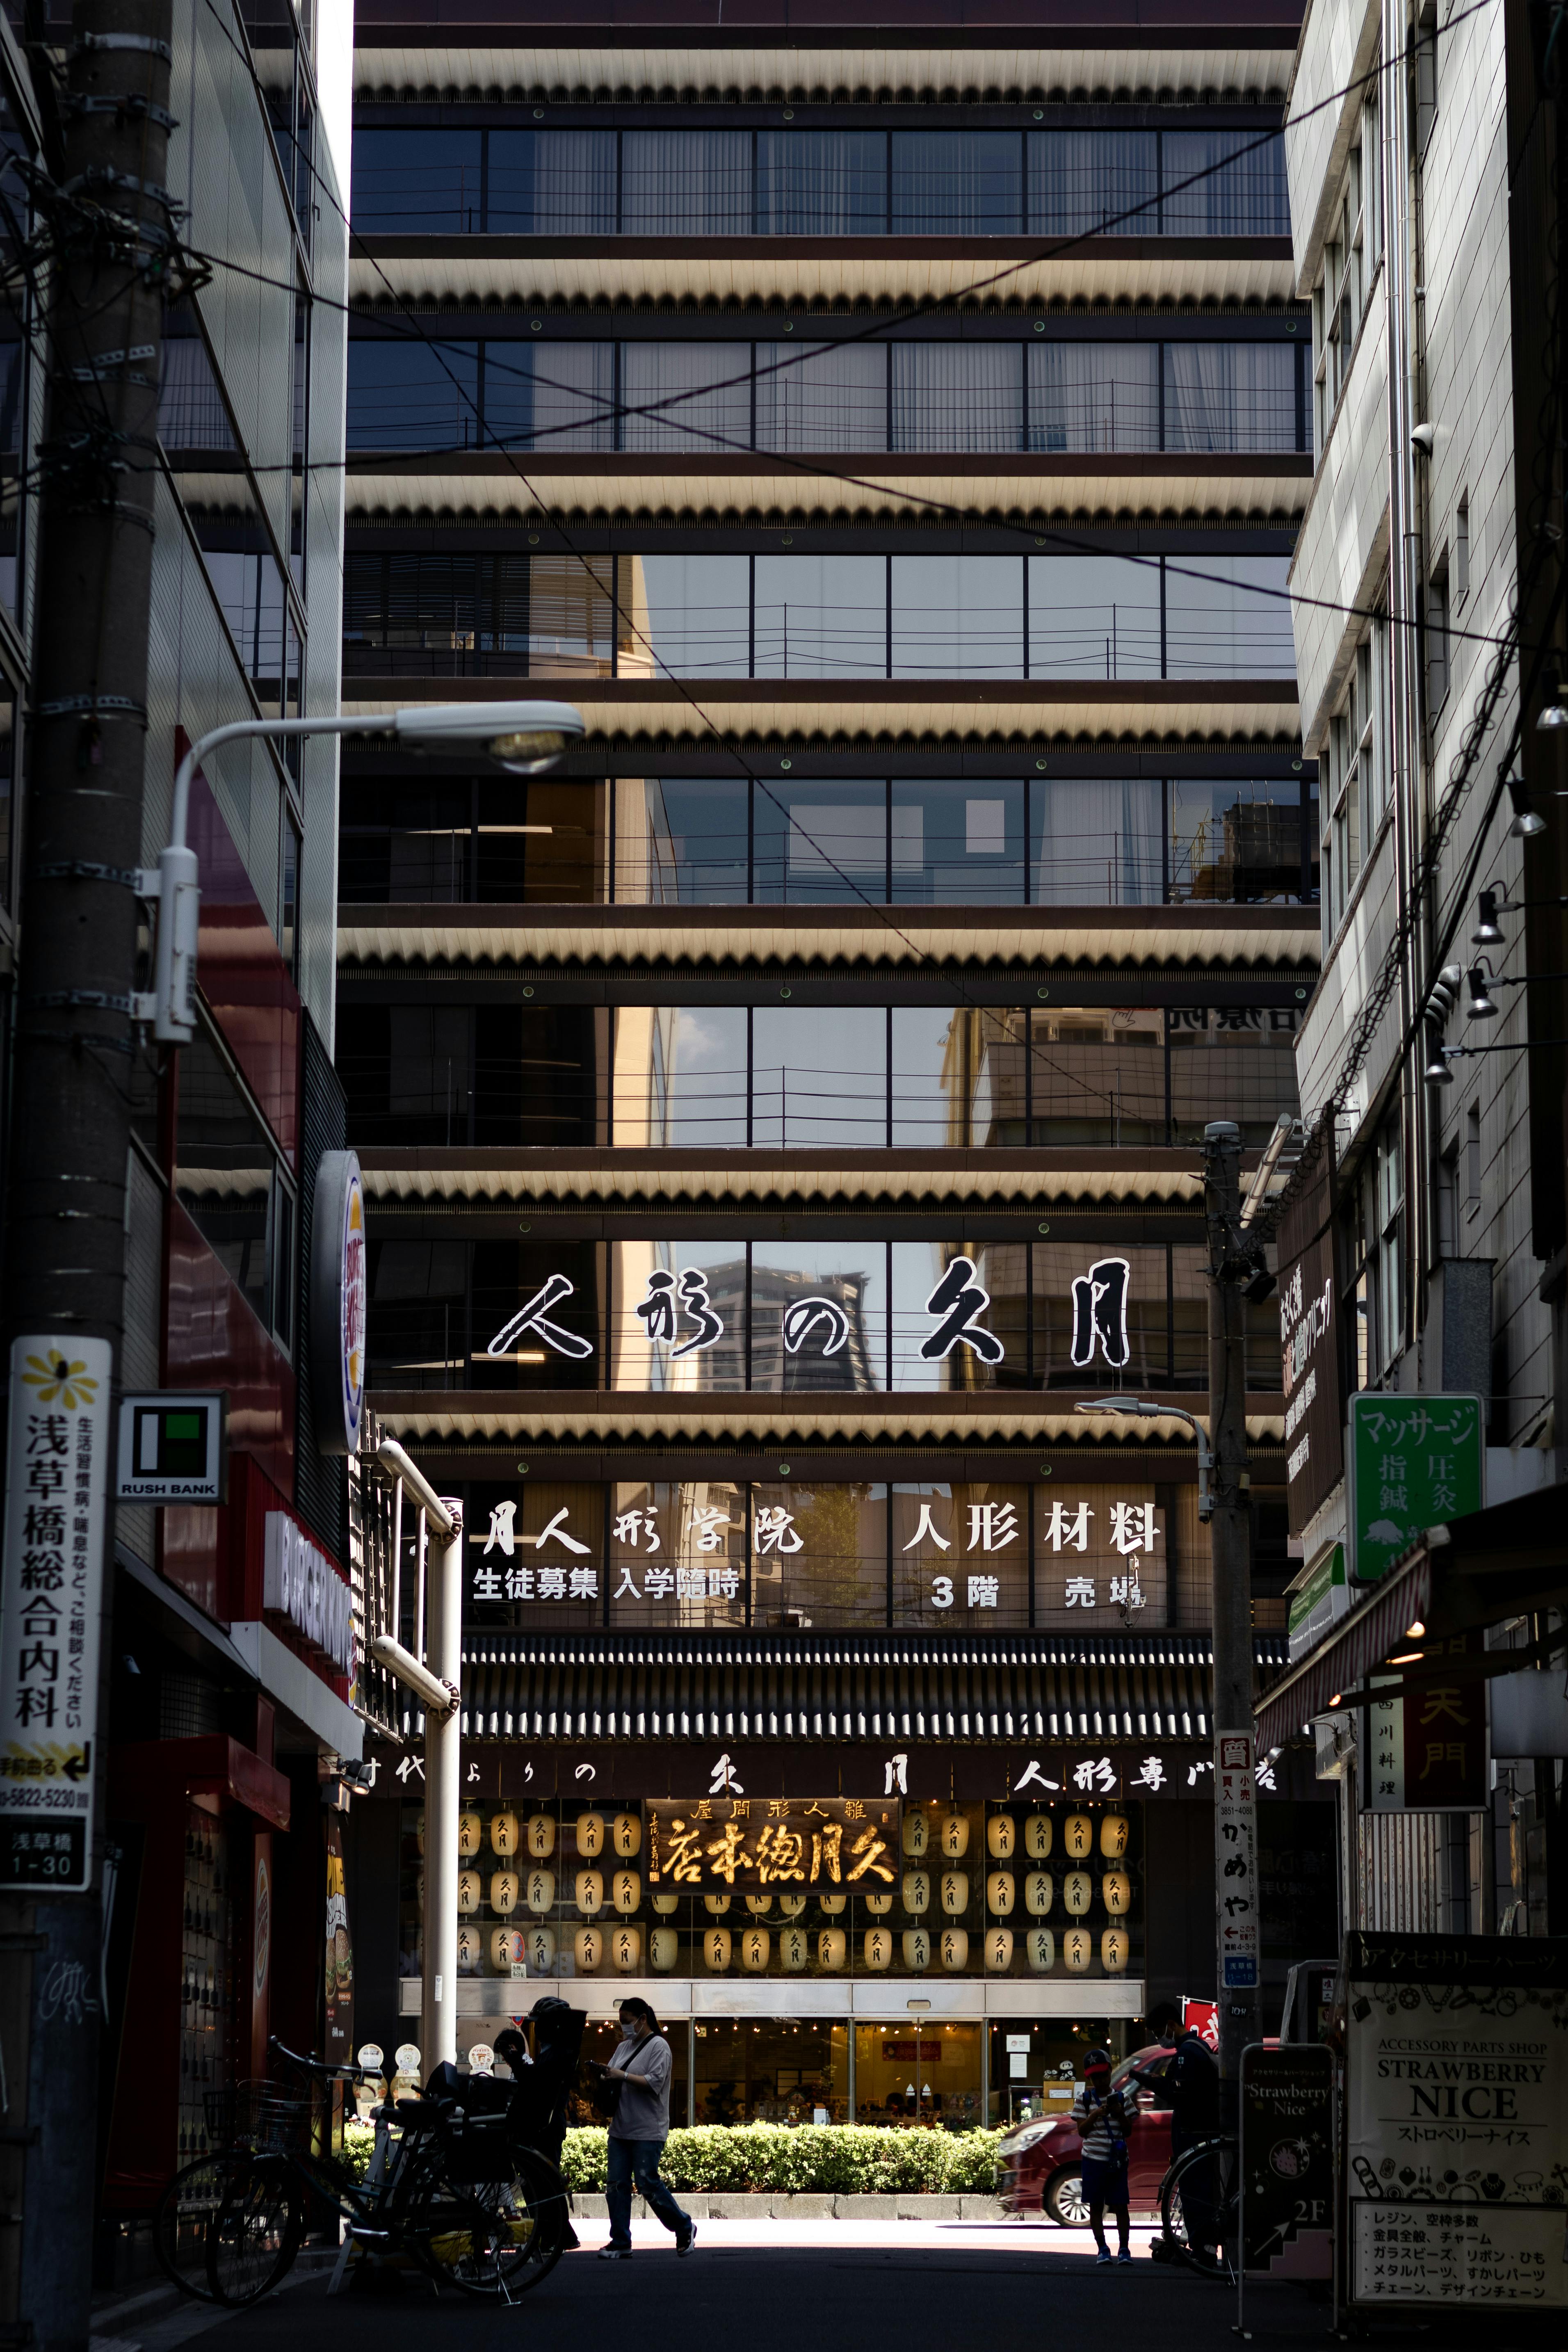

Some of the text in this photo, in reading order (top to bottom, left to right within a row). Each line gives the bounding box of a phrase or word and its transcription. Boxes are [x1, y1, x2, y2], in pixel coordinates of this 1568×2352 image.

[487, 1256, 1130, 1367] 人形の久月
[1360, 1405, 1475, 1447] マッサージ
[1378, 1453, 1456, 1481] 指圧
[123, 1484, 216, 1494] RUSH BANK
[1379, 1483, 1457, 1512] 鍼灸
[409, 1500, 804, 1556] 月人形学院
[902, 1502, 1160, 1552] 人形材料
[15, 1414, 69, 1728] 浅草橋総合内科
[473, 1567, 598, 1600] 生徒募集
[931, 1576, 1141, 1608] 3階 売場
[0, 1758, 57, 1776] 手前曲る
[1223, 1739, 1247, 1767] 質
[708, 1754, 908, 1795] 久月
[1222, 1776, 1233, 1801] 買入
[1240, 1775, 1251, 1801] 小売
[1221, 1806, 1253, 1815] 3851-4088
[11, 1831, 73, 1852] 浅草橋
[461, 1819, 470, 1847] 久月
[498, 1819, 508, 1847] 久月
[536, 1820, 546, 1849] 久月
[587, 1820, 596, 1848] 久月
[621, 1819, 632, 1848] 久月
[914, 1819, 924, 1847] 久月
[949, 1822, 959, 1849] 久月
[999, 1821, 1009, 1849] 久月
[1036, 1821, 1046, 1849] 久月
[1074, 1821, 1084, 1849] 久月
[1116, 1822, 1126, 1850] 久月
[12, 1854, 71, 1876] 1-30
[1221, 1823, 1248, 1917] かめや
[461, 1877, 470, 1905] 久月
[501, 1878, 511, 1906] 久月
[533, 1875, 543, 1903] 久月
[584, 1877, 594, 1905] 久月
[622, 1877, 632, 1904] 久月
[915, 1877, 925, 1905] 久月
[946, 1878, 956, 1905] 久月
[997, 1878, 1008, 1906] 久月
[1036, 1878, 1047, 1906] 久月
[1073, 1878, 1082, 1906] 久月
[1110, 1878, 1120, 1906] 久月
[459, 1932, 470, 1961] 久月
[498, 1934, 509, 1962] 久月
[536, 1935, 546, 1963] 久月
[584, 1934, 594, 1962] 久月
[620, 1934, 630, 1962] 久月
[651, 1933, 659, 1963] 久月
[713, 1934, 724, 1963] 久月
[751, 1934, 761, 1963] 久月
[790, 1934, 801, 1963] 久月
[822, 1934, 831, 1963] 久月
[872, 1933, 882, 1962] 久月
[915, 1936, 925, 1963] 久月
[945, 1935, 954, 1962] 久月
[996, 1935, 1006, 1963] 久月
[1038, 1934, 1048, 1962] 久月
[1072, 1935, 1082, 1963] 久月
[1109, 1935, 1119, 1963] 久月
[1379, 2039, 1547, 2054] ACCESSORY PARTS SHOP
[1378, 2059, 1546, 2083] STRAWBERRY
[1249, 2082, 1329, 2103] Strawberry
[1409, 2085, 1518, 2119] NICE
[1273, 2101, 1306, 2116] Nice
[1398, 2125, 1530, 2146] ストロベリーナイス
[1294, 2199, 1326, 2222] 2F
